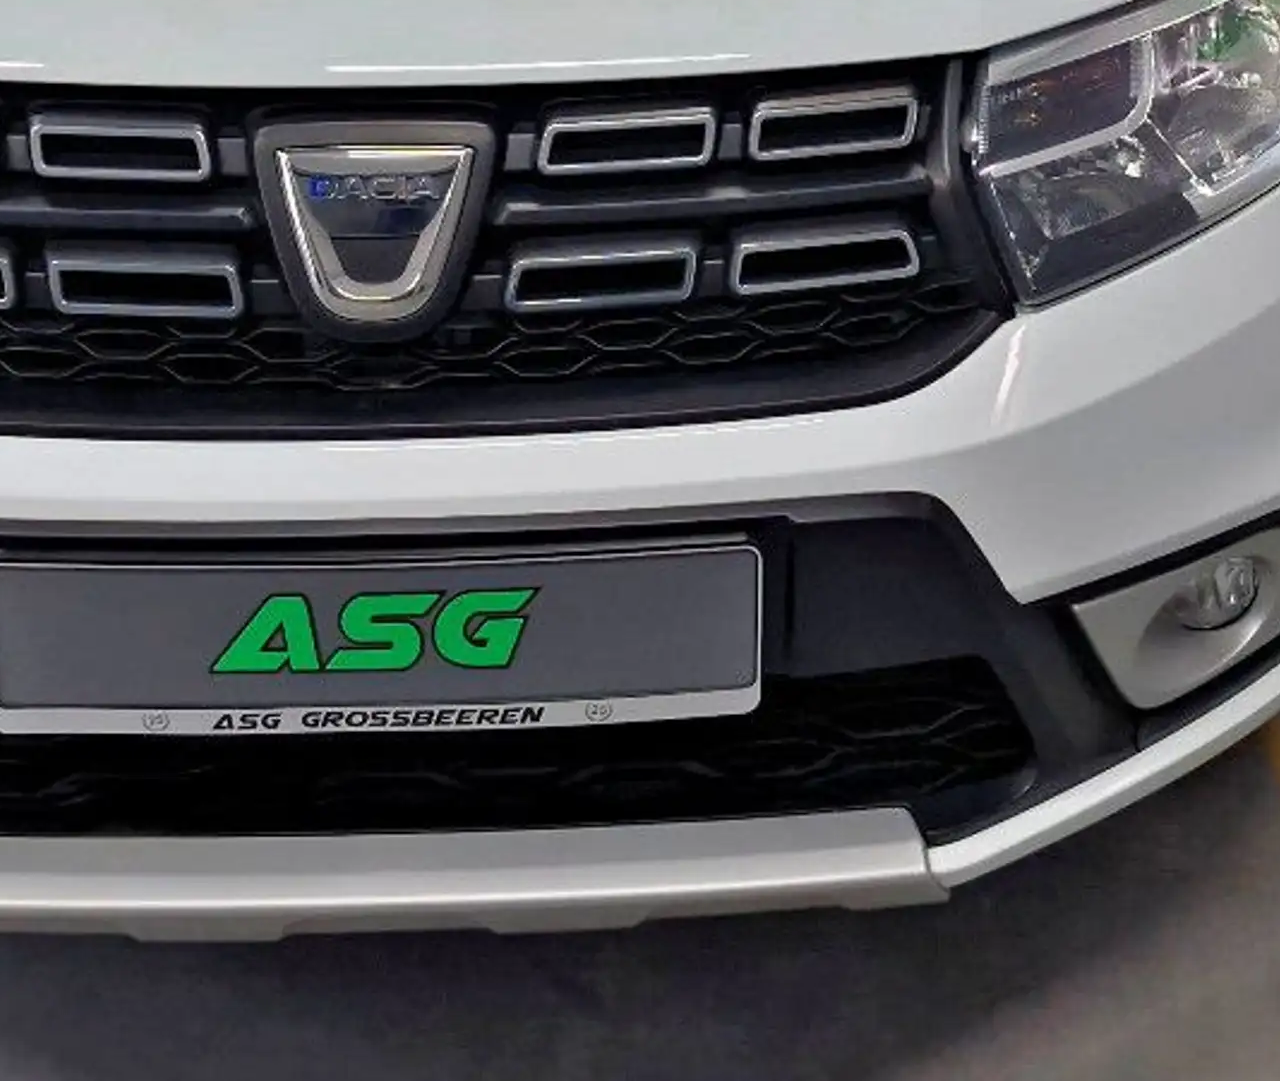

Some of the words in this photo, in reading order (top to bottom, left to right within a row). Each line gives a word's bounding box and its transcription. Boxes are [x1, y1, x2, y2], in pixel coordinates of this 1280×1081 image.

[308, 174, 440, 200] DACIA
[210, 587, 542, 674] ASG
[213, 713, 283, 730] ASG
[301, 706, 545, 728] GROSSBEEREN
